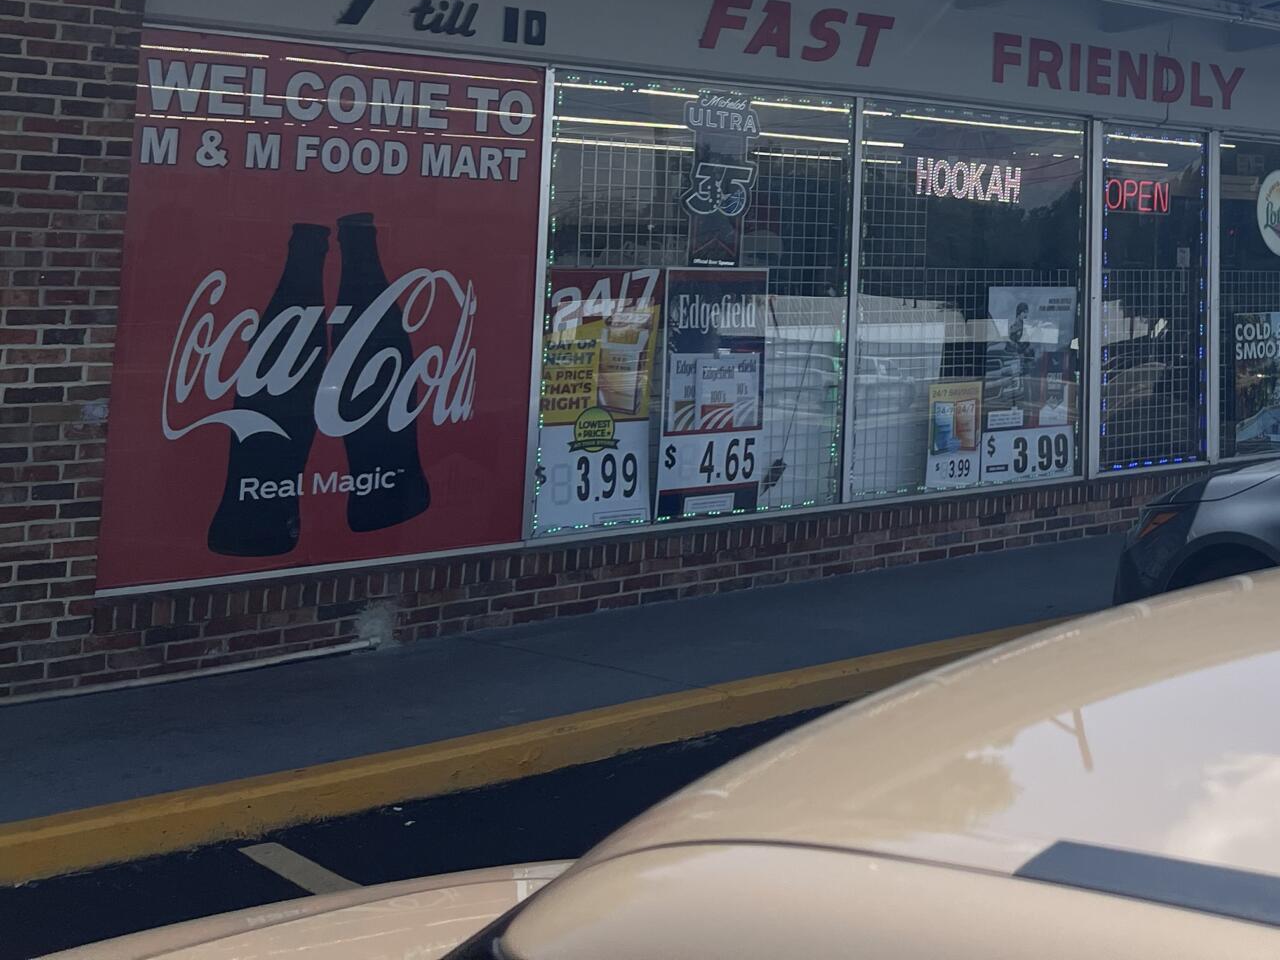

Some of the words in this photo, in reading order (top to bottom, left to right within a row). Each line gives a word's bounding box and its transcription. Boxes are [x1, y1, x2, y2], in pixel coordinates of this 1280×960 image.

[991, 31, 1246, 110] FRIENDLY
[146, 57, 450, 131] WELCOME
[465, 84, 536, 136] TO
[689, 106, 757, 134] ULTRA
[139, 126, 179, 165] M
[196, 129, 228, 168] &
[244, 132, 282, 171] M
[295, 135, 409, 176] FOOD
[420, 143, 527, 181] MART
[914, 156, 1022, 204] HOOKAH
[1104, 178, 1170, 214] OPEN
[678, 294, 756, 336] Edgefield
[1235, 322, 1271, 341] COLD
[161, 268, 477, 442] Coca-Cola
[546, 351, 596, 365] NIGHT
[543, 382, 592, 395] THAT'S
[556, 369, 593, 380] PRICE
[541, 396, 592, 411] RIGHT
[578, 420, 611, 430] LOWEST
[583, 429, 607, 438] PRICE
[665, 443, 677, 469] $
[699, 437, 756, 484] 4.65
[948, 458, 970, 478] 3.99
[986, 434, 996, 458] $
[1013, 433, 1070, 474] 3.99
[239, 472, 304, 501] Real
[312, 466, 397, 498] Magic
[576, 452, 639, 502] 3.99
